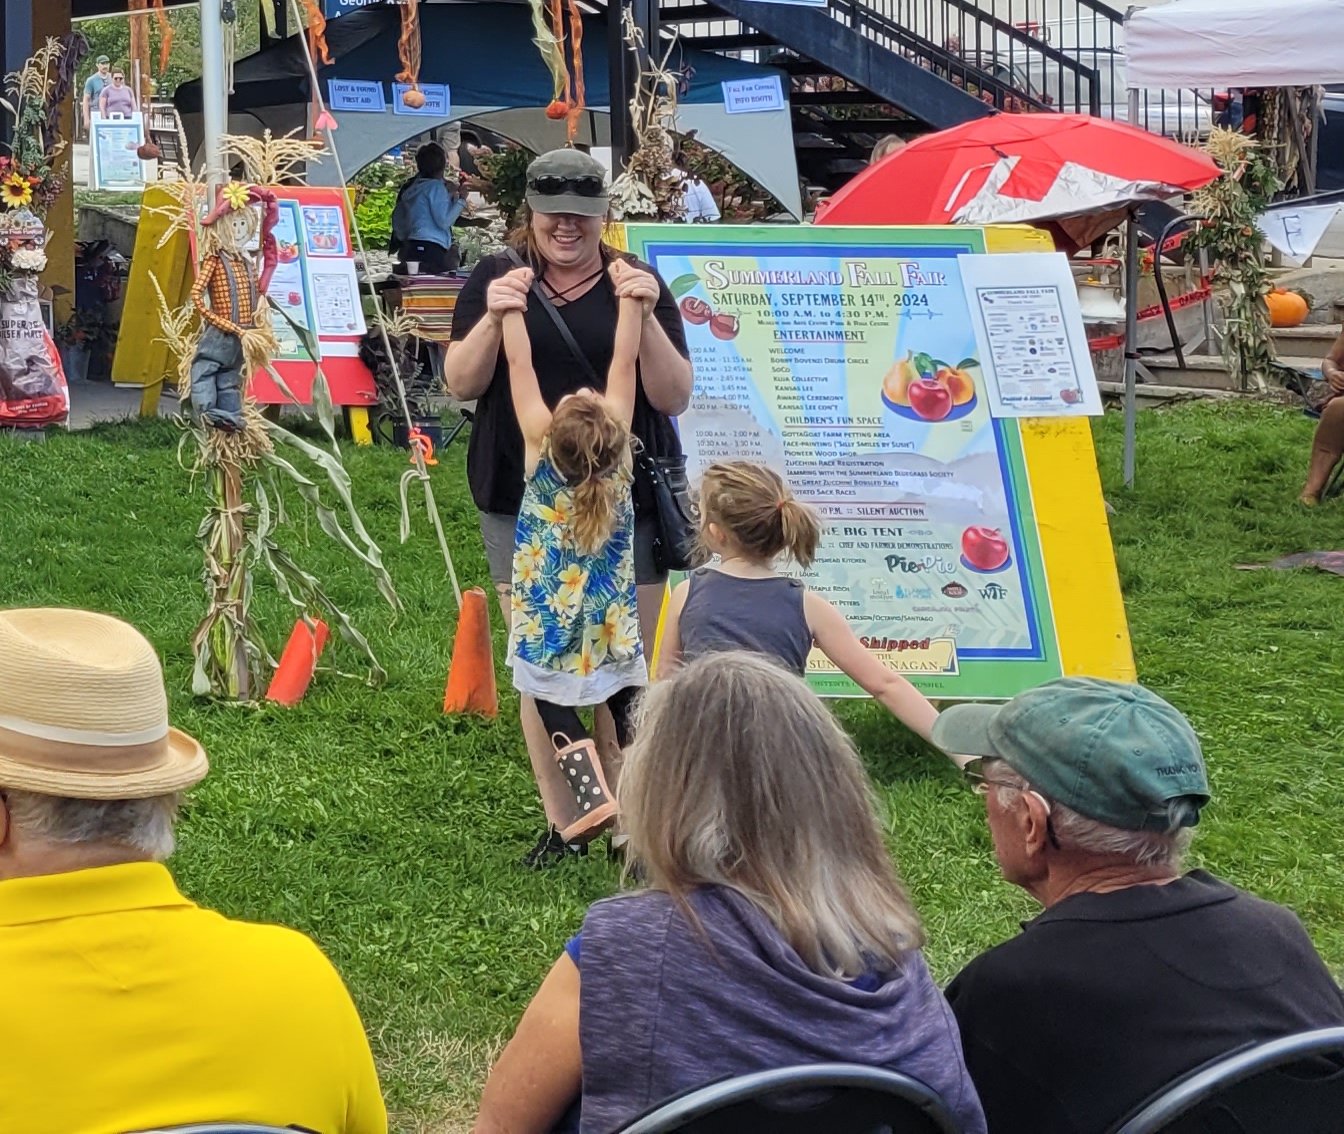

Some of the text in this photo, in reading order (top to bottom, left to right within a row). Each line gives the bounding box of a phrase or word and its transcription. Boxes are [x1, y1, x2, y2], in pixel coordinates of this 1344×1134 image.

[703, 260, 948, 290] SUMMERLAND FALL FAIR
[712, 292, 778, 308] SATURDAY,
[782, 293, 856, 307] SEPTEMBER
[893, 293, 929, 307] 2024
[757, 310, 789, 318] 10:00
[793, 310, 816, 318] A.M.
[835, 310, 860, 318] 4:30
[865, 310, 889, 318] P.M.
[773, 330, 865, 341] ENTERTAINMENT
[768, 347, 805, 355] WELCOME
[784, 416, 884, 425] CHILDREN'S FUN SPACE
[837, 460, 884, 468] REGISTRATION
[857, 507, 886, 516] SILENT
[888, 508, 925, 516] AUCTION
[843, 527, 904, 537] BIG TENT
[897, 542, 954, 550] DEMONSTRATIONS
[884, 554, 921, 574] Pie
[859, 635, 931, 651] Shipped
